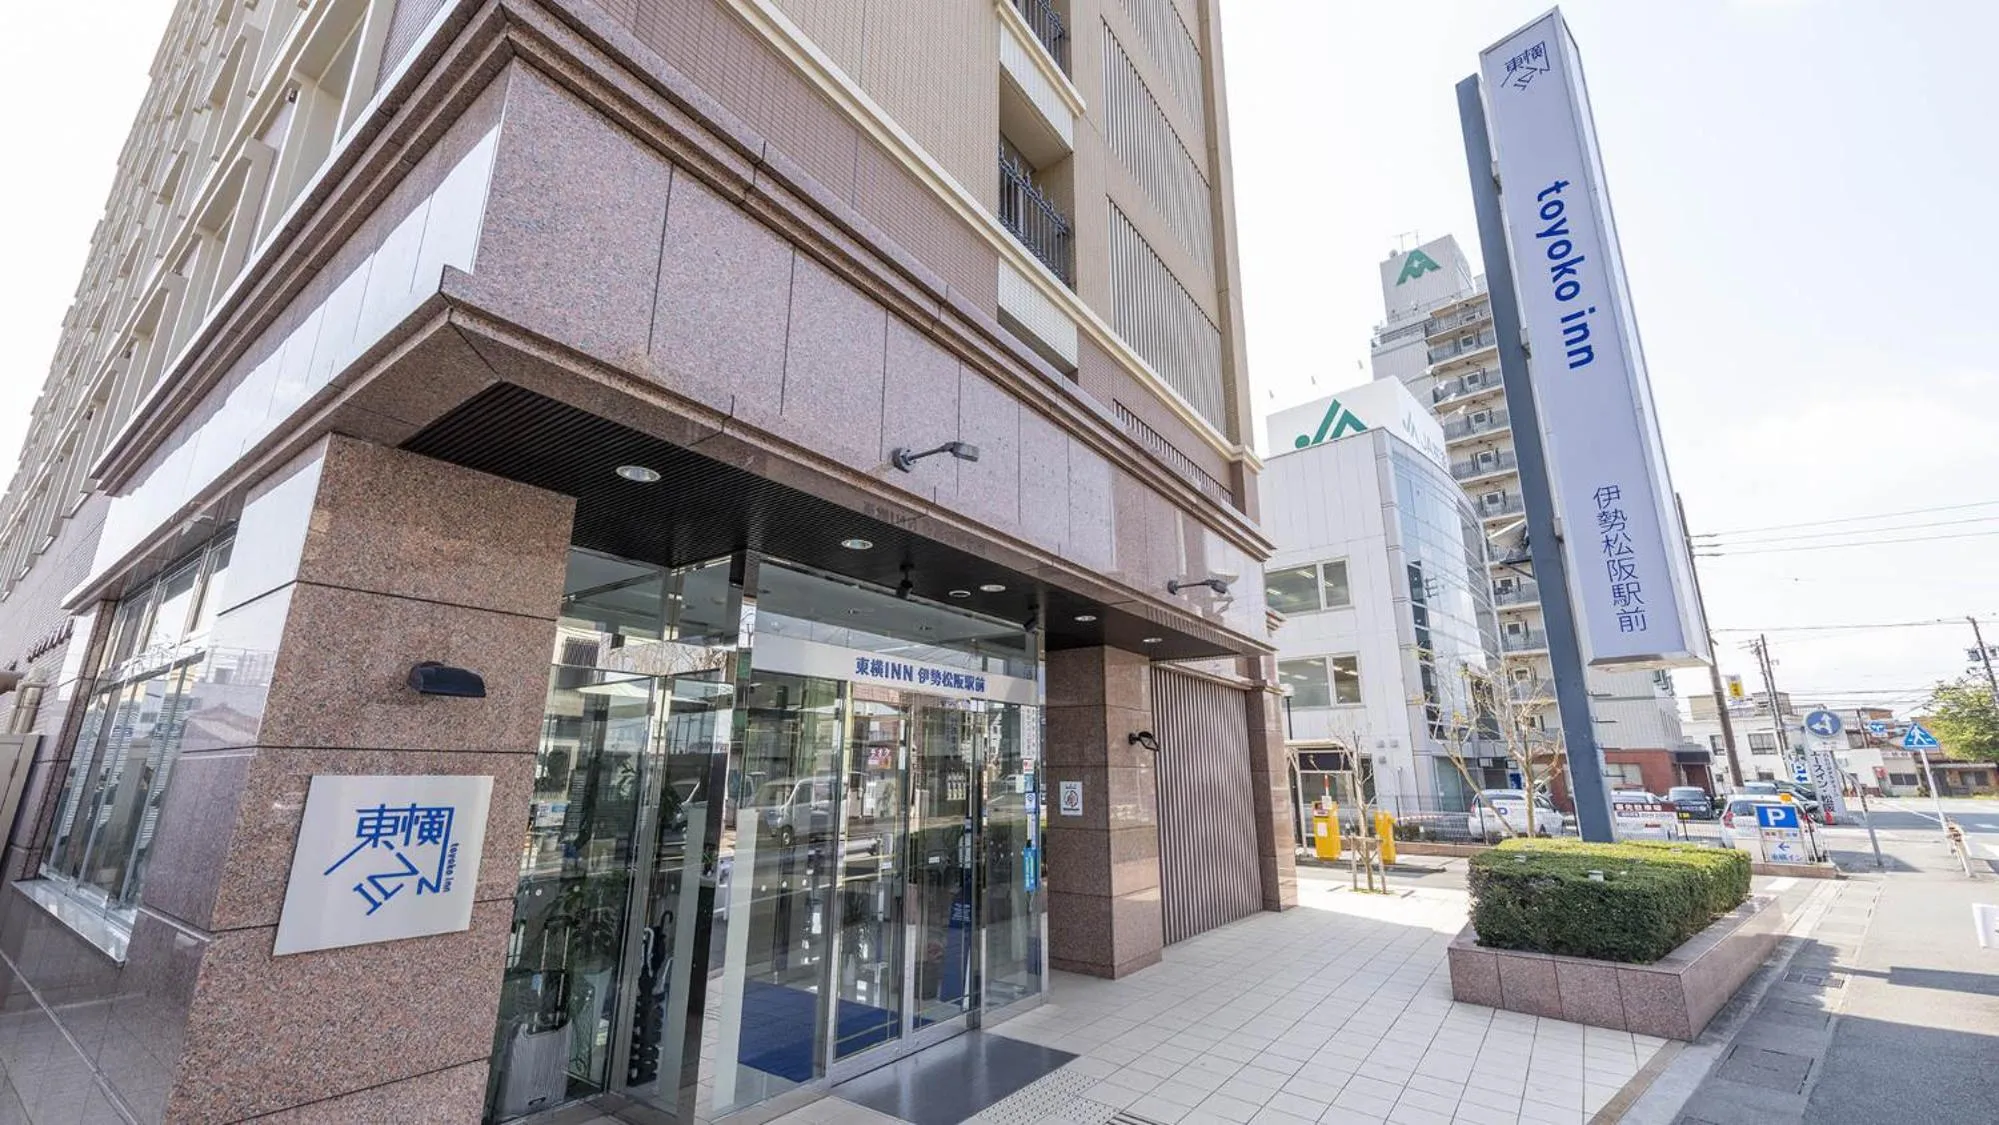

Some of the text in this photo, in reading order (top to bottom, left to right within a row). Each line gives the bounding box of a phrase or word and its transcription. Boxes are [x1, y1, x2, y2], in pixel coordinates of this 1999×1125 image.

[1536, 180, 1596, 370] toyoko inn
[1593, 484, 1647, 633] 伊勢松阪駅前
[855, 656, 986, 693] 東横INN 伊勢松阪駅前
[1766, 808, 1786, 826] P
[445, 842, 460, 876] toyoko
